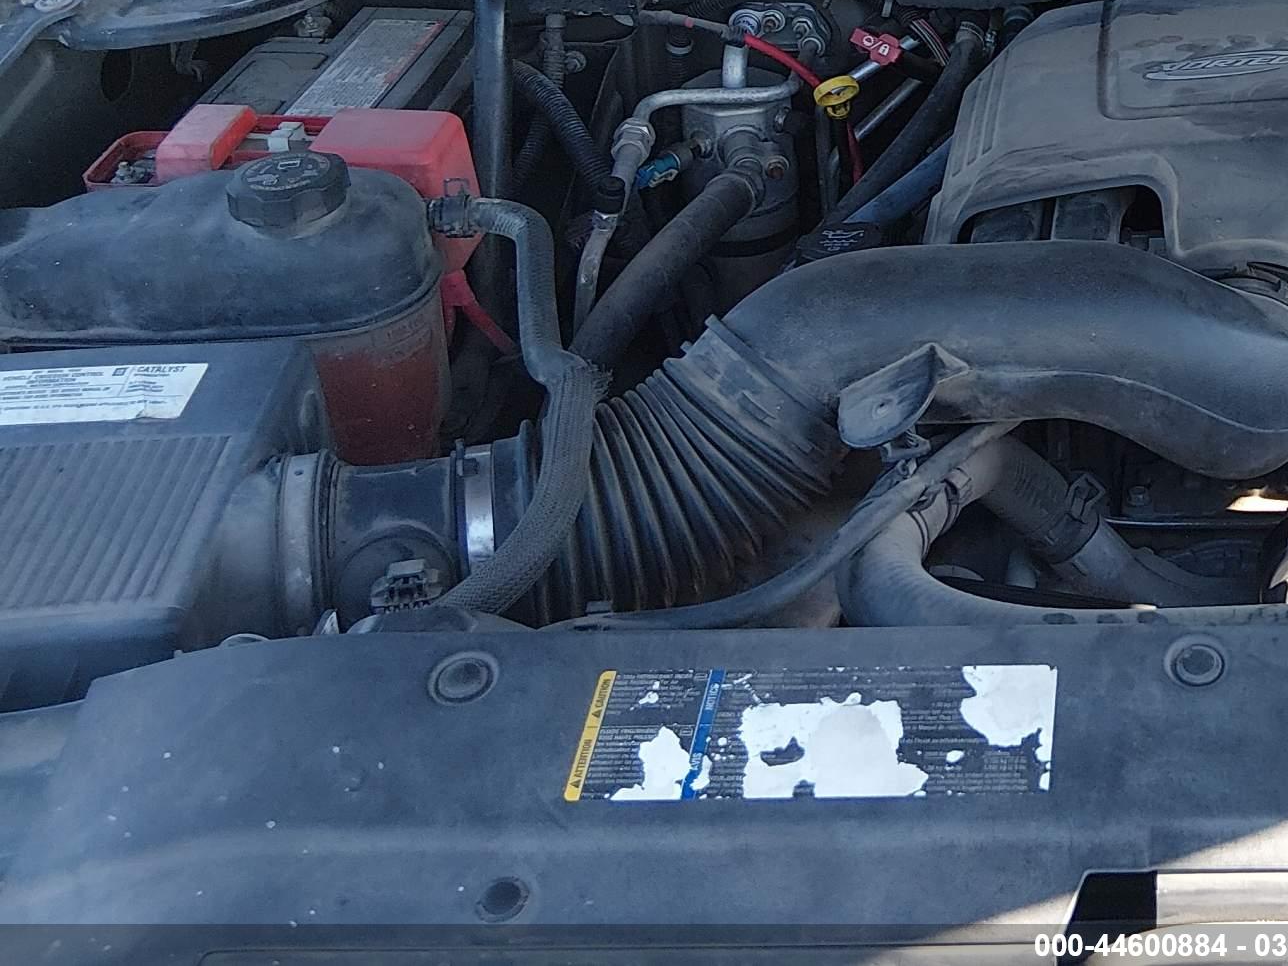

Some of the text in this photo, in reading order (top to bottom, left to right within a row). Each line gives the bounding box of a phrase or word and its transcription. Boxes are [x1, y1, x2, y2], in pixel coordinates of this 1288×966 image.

[137, 365, 187, 373] CATALYST
[595, 679, 611, 708] CAUTION
[574, 739, 592, 778] ATTENTION
